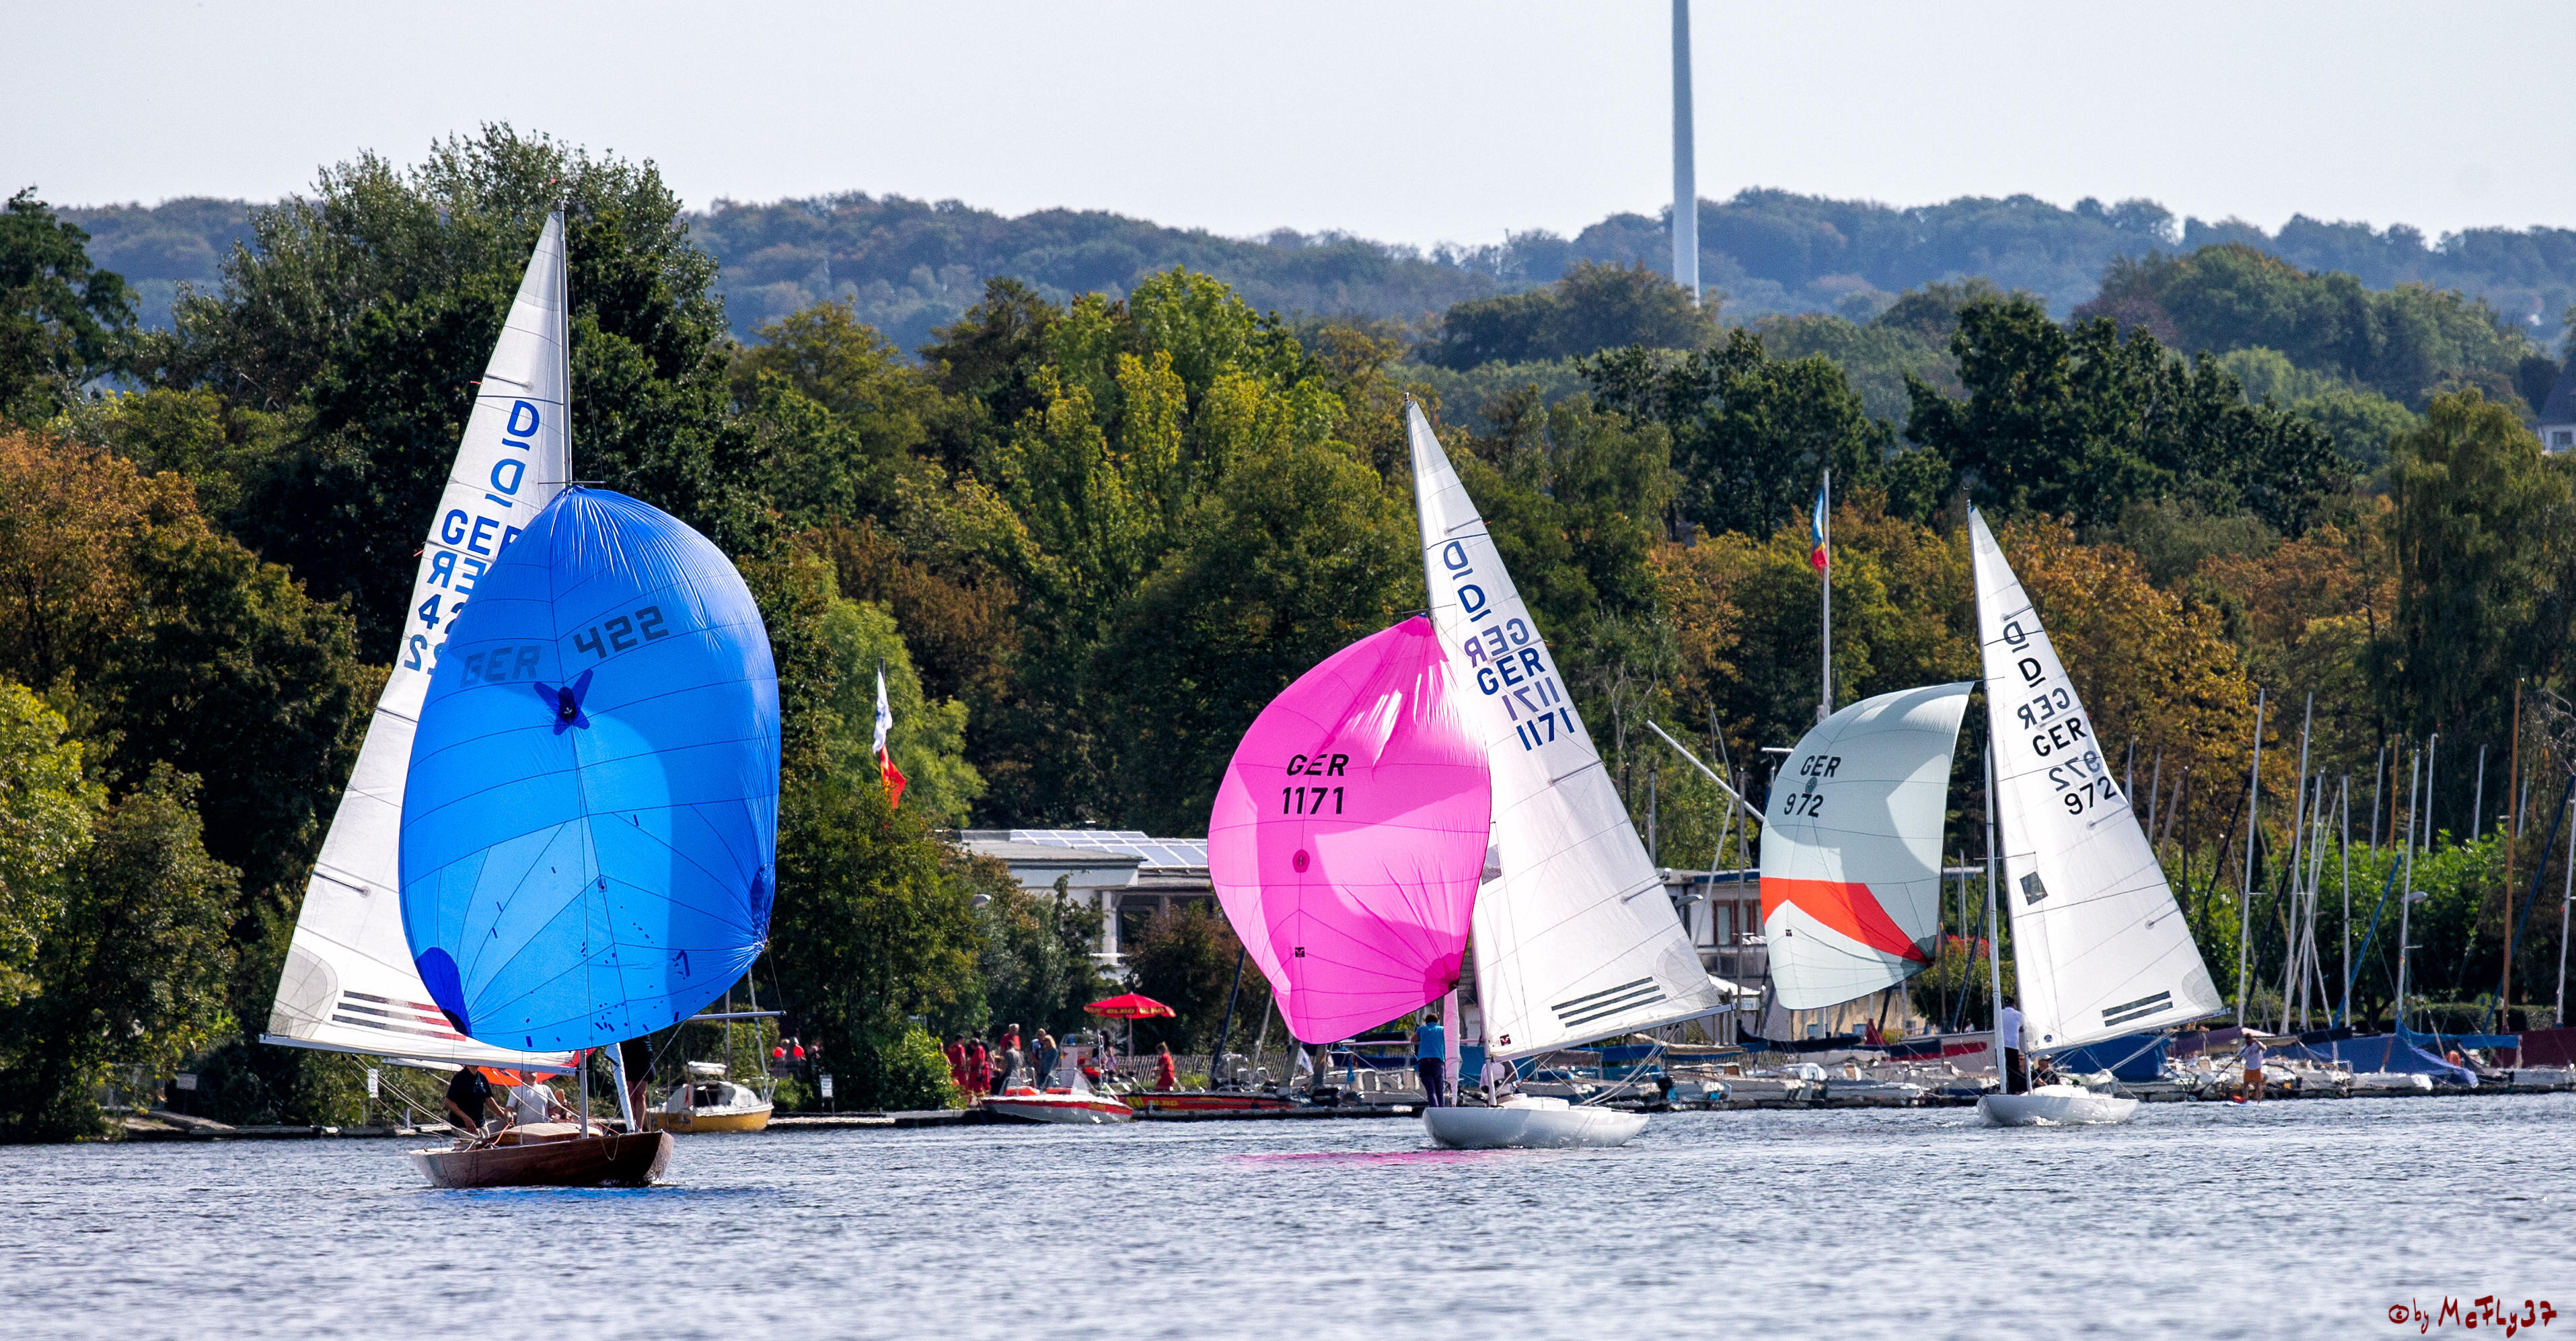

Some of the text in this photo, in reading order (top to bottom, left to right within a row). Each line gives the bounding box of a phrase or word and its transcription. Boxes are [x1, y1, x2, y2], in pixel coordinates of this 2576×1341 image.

[573, 605, 669, 660] 422
[1477, 647, 1546, 696] GER
[1516, 706, 1575, 752] 1171
[2032, 717, 2088, 757] GER
[1286, 754, 1350, 776] GER
[1800, 755, 1841, 778] GER
[1282, 787, 1344, 815] 1171
[1783, 793, 1824, 818] 972
[2064, 776, 2117, 815] 972
